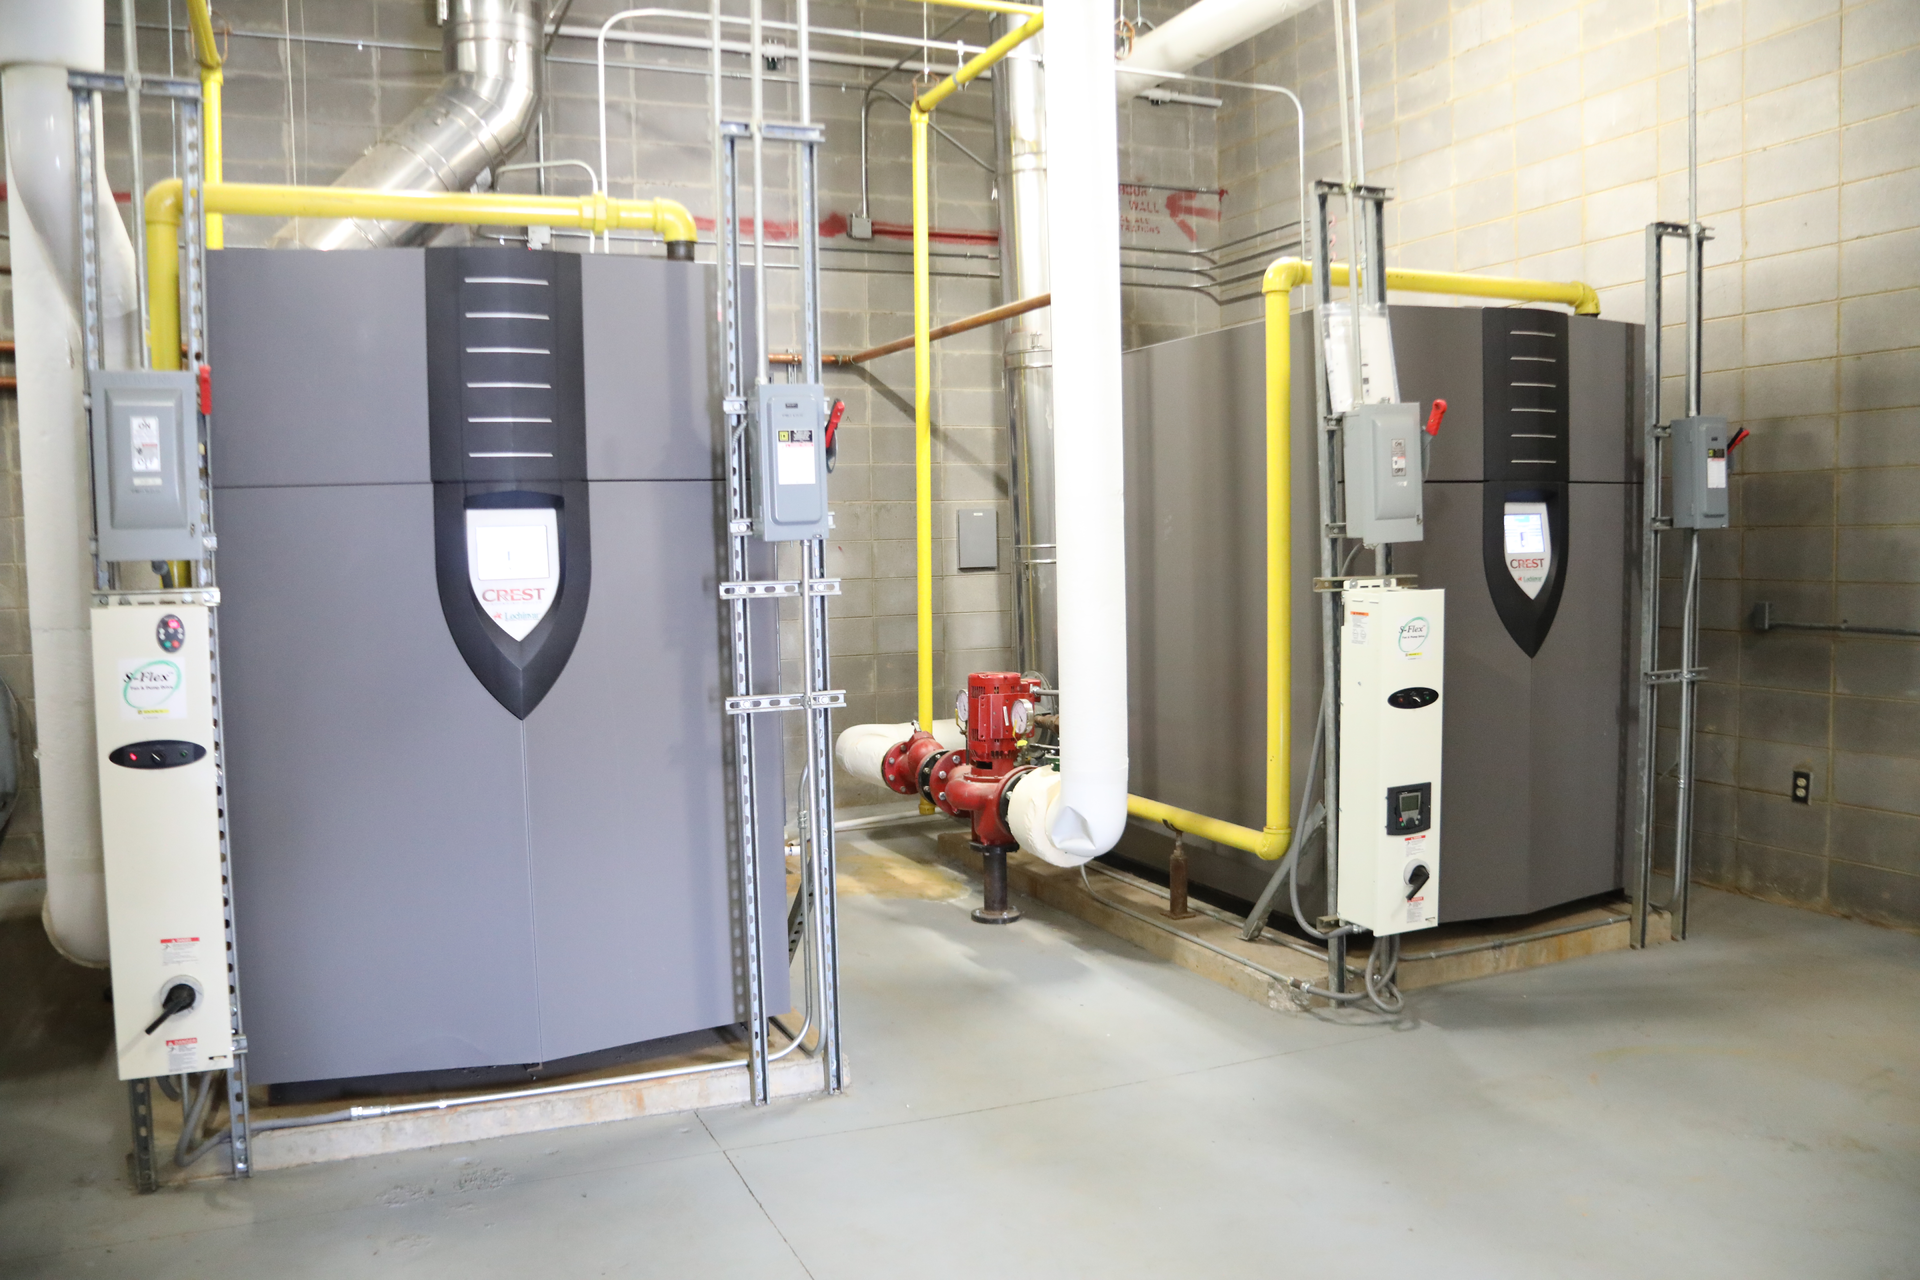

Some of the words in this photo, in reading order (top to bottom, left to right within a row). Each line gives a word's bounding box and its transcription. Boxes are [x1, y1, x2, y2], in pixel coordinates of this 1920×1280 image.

[1129, 200, 1159, 214] WALL
[1509, 558, 1544, 569] CREST
[482, 588, 545, 602] CREST
[123, 671, 169, 684] S-Flex
